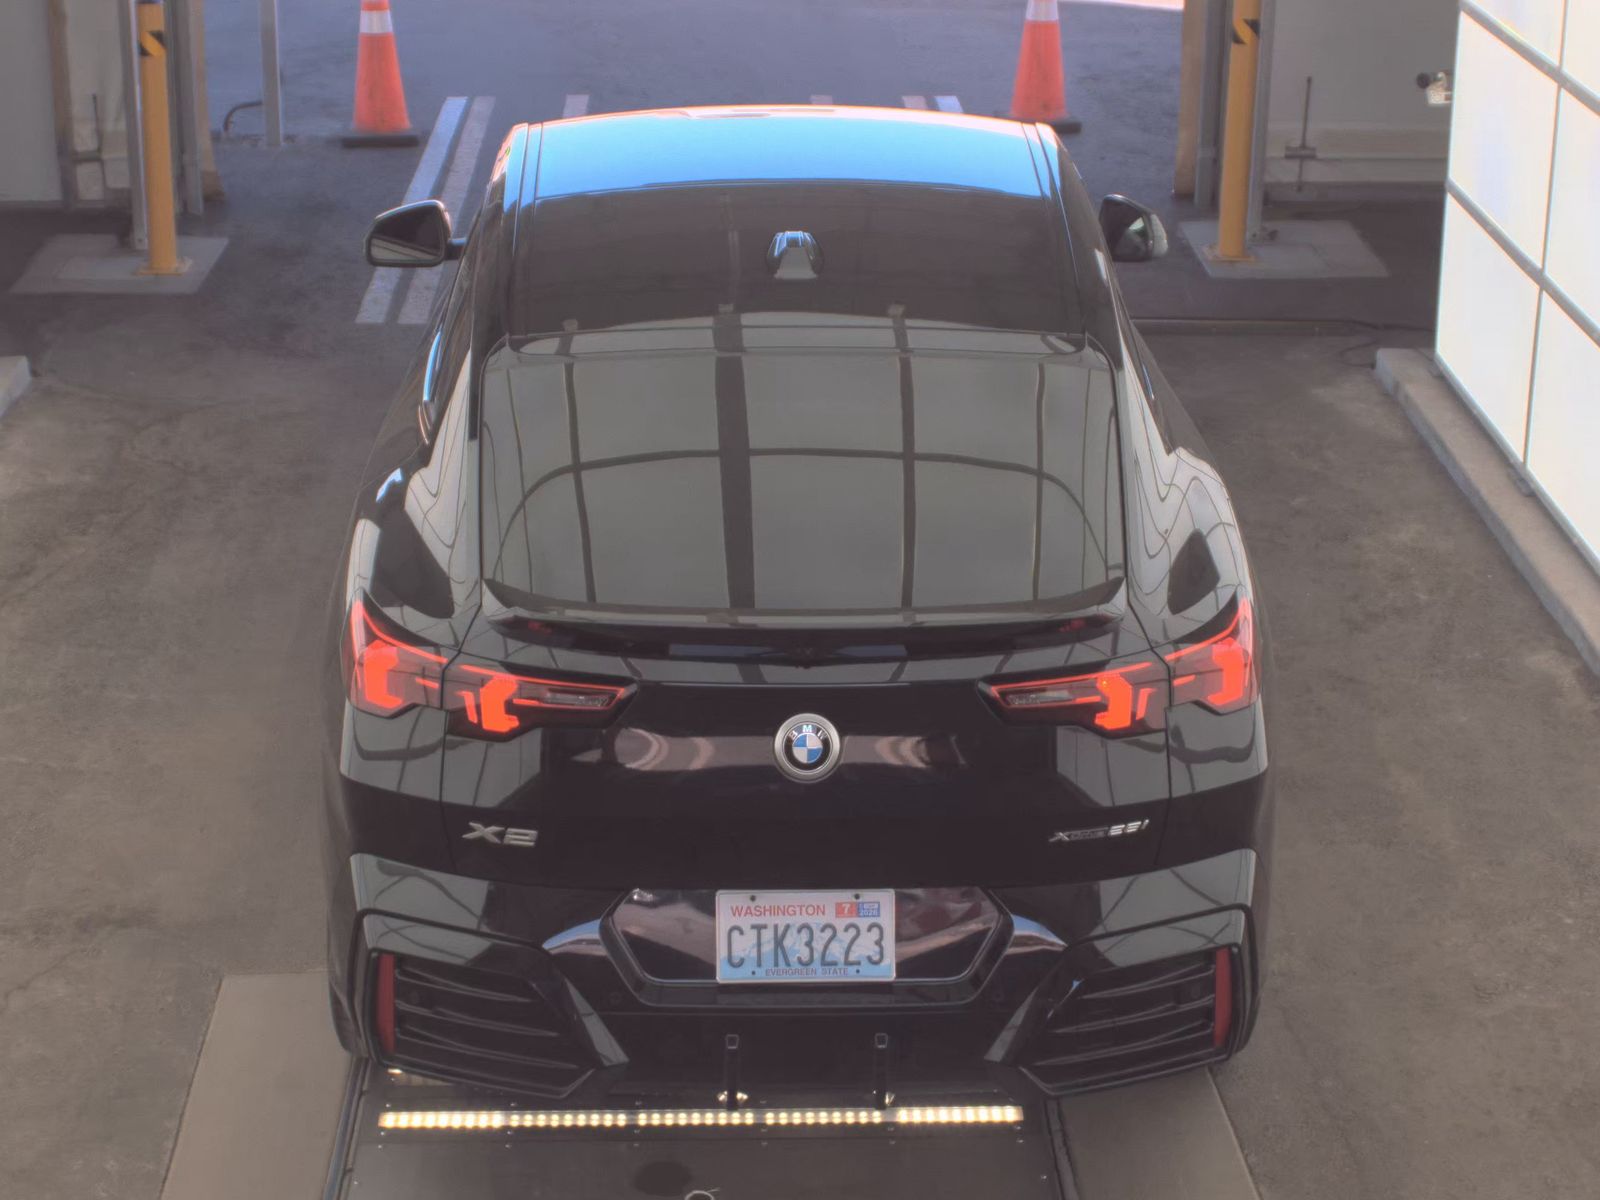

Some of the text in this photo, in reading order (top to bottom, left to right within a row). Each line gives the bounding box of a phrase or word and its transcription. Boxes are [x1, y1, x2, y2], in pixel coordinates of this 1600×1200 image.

[787, 724, 828, 740] BMW
[462, 822, 538, 847] X2
[730, 904, 826, 917] WASHINGTON
[727, 922, 884, 968] CTK3223
[765, 967, 849, 976] EVERGREEN STATE
